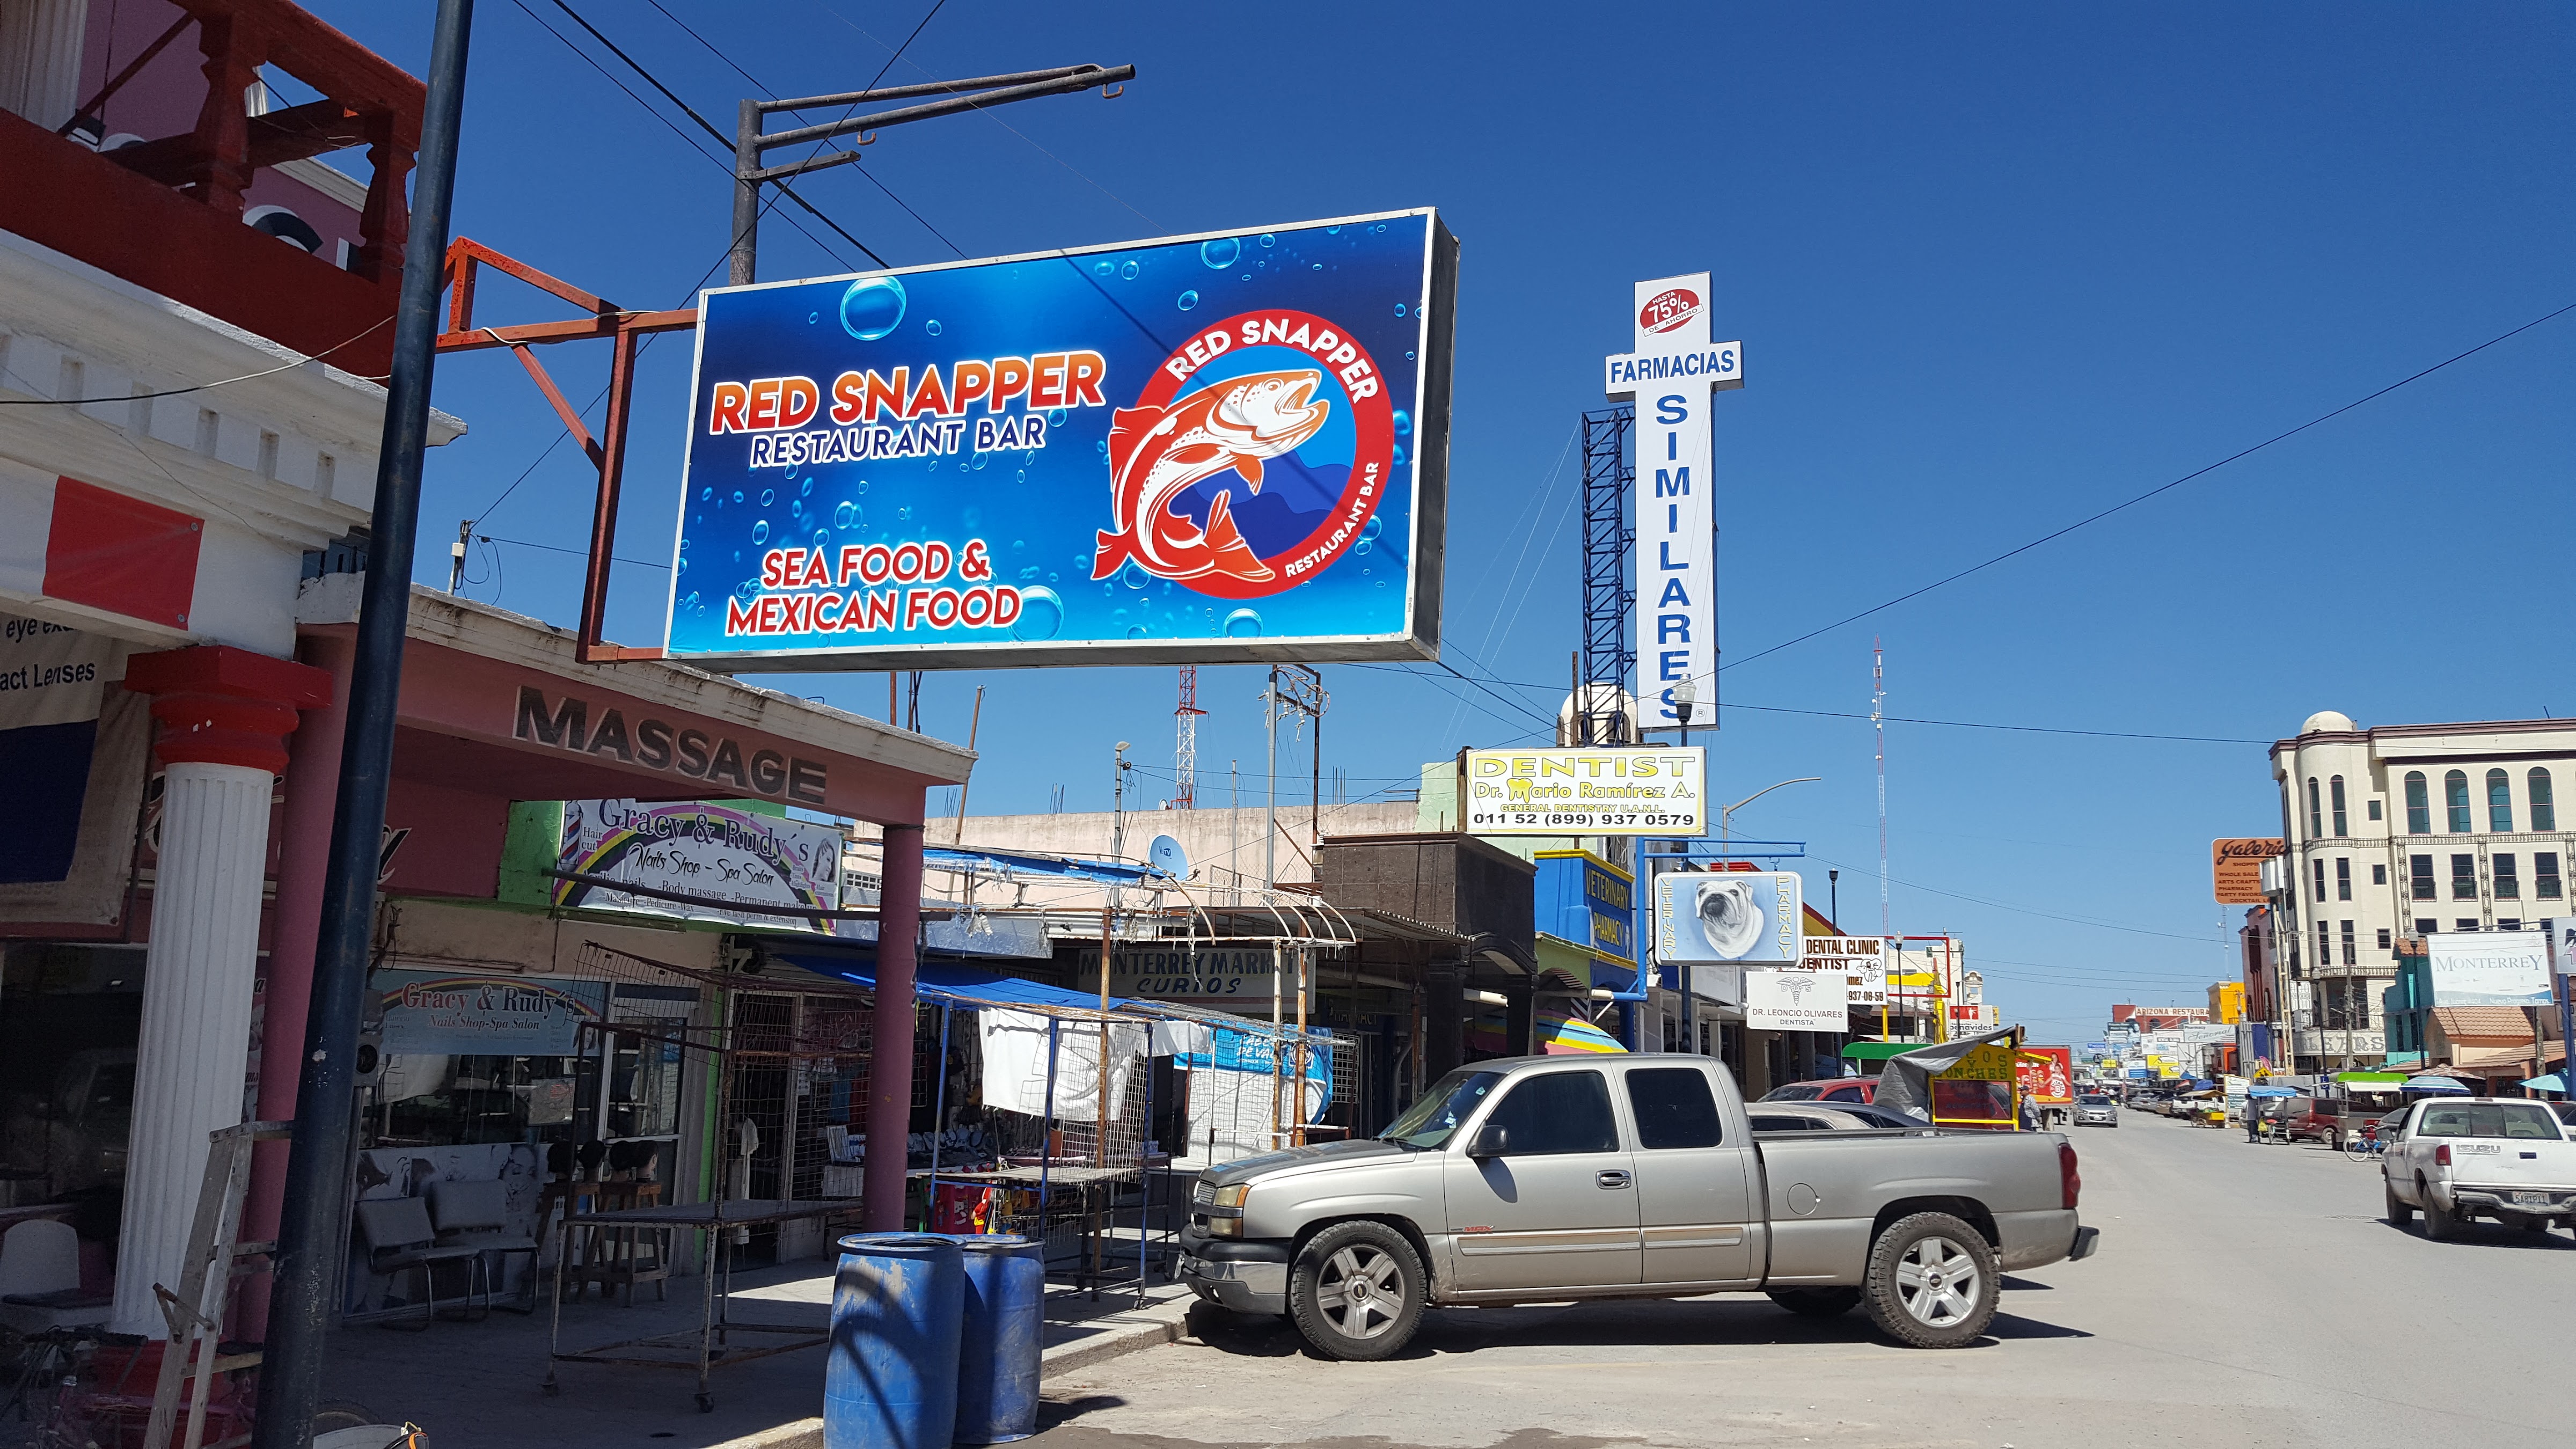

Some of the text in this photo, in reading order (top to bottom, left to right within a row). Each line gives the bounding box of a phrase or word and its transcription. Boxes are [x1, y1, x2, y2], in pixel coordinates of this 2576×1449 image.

[1648, 294, 1689, 323] 75%
[1652, 291, 1676, 305] HASTA
[1649, 308, 1697, 333] DE AHORRO
[1165, 318, 1379, 404] RED SNAPPER
[1611, 350, 1734, 383] FARMACIAS
[709, 350, 1106, 436] RED SNAPPER
[750, 415, 1046, 467] RESTAURANT BAR
[1285, 462, 1379, 578] RESTAURANT BAR
[760, 538, 992, 590] SEA FOOD &
[724, 585, 1023, 637] MEXICAN FOOD
[6, 619, 37, 643] eye
[34, 663, 95, 687] Lenses
[511, 685, 827, 805] MASSAGE
[1475, 756, 1696, 778] DENTIST
[1475, 778, 1695, 803] Dr. Mario Ramírez A.
[1473, 813, 1694, 827] 011 52 (899) 937 0579
[1554, 804, 1616, 813] DENTISTRY
[1620, 804, 1665, 813] U.A.N.L.
[582, 826, 603, 840] Hair
[599, 798, 685, 846] Gracy
[693, 807, 714, 850] &
[582, 840, 597, 851] cut
[628, 844, 667, 870] Nails
[668, 850, 701, 878] Shop
[715, 859, 741, 881] Spa
[741, 862, 774, 887] Salon
[688, 887, 727, 901] massage
[1585, 867, 1629, 912] VETERINARY
[747, 913, 762, 921] perm
[770, 916, 797, 925] extension
[1661, 878, 1677, 959] VETERINARY
[1775, 876, 1793, 958] PHARMACY
[1593, 911, 1624, 948] PHARMACY
[1806, 939, 1879, 955] DENTAL CLINIC
[1080, 953, 1297, 975] MNTERREY MARKT
[2434, 955, 2543, 971] MONTERREY
[1137, 977, 1242, 993] CURIOS
[1847, 976, 1863, 986] mez
[401, 982, 469, 1016] Gracy
[477, 980, 494, 1016] &
[428, 1014, 456, 1028] Nails
[512, 1016, 539, 1030] Salon
[1768, 1009, 1802, 1017] LEONCIO
[1804, 1010, 1843, 1018] OLIVARES
[2456, 1145, 2501, 1153] ISUZU
